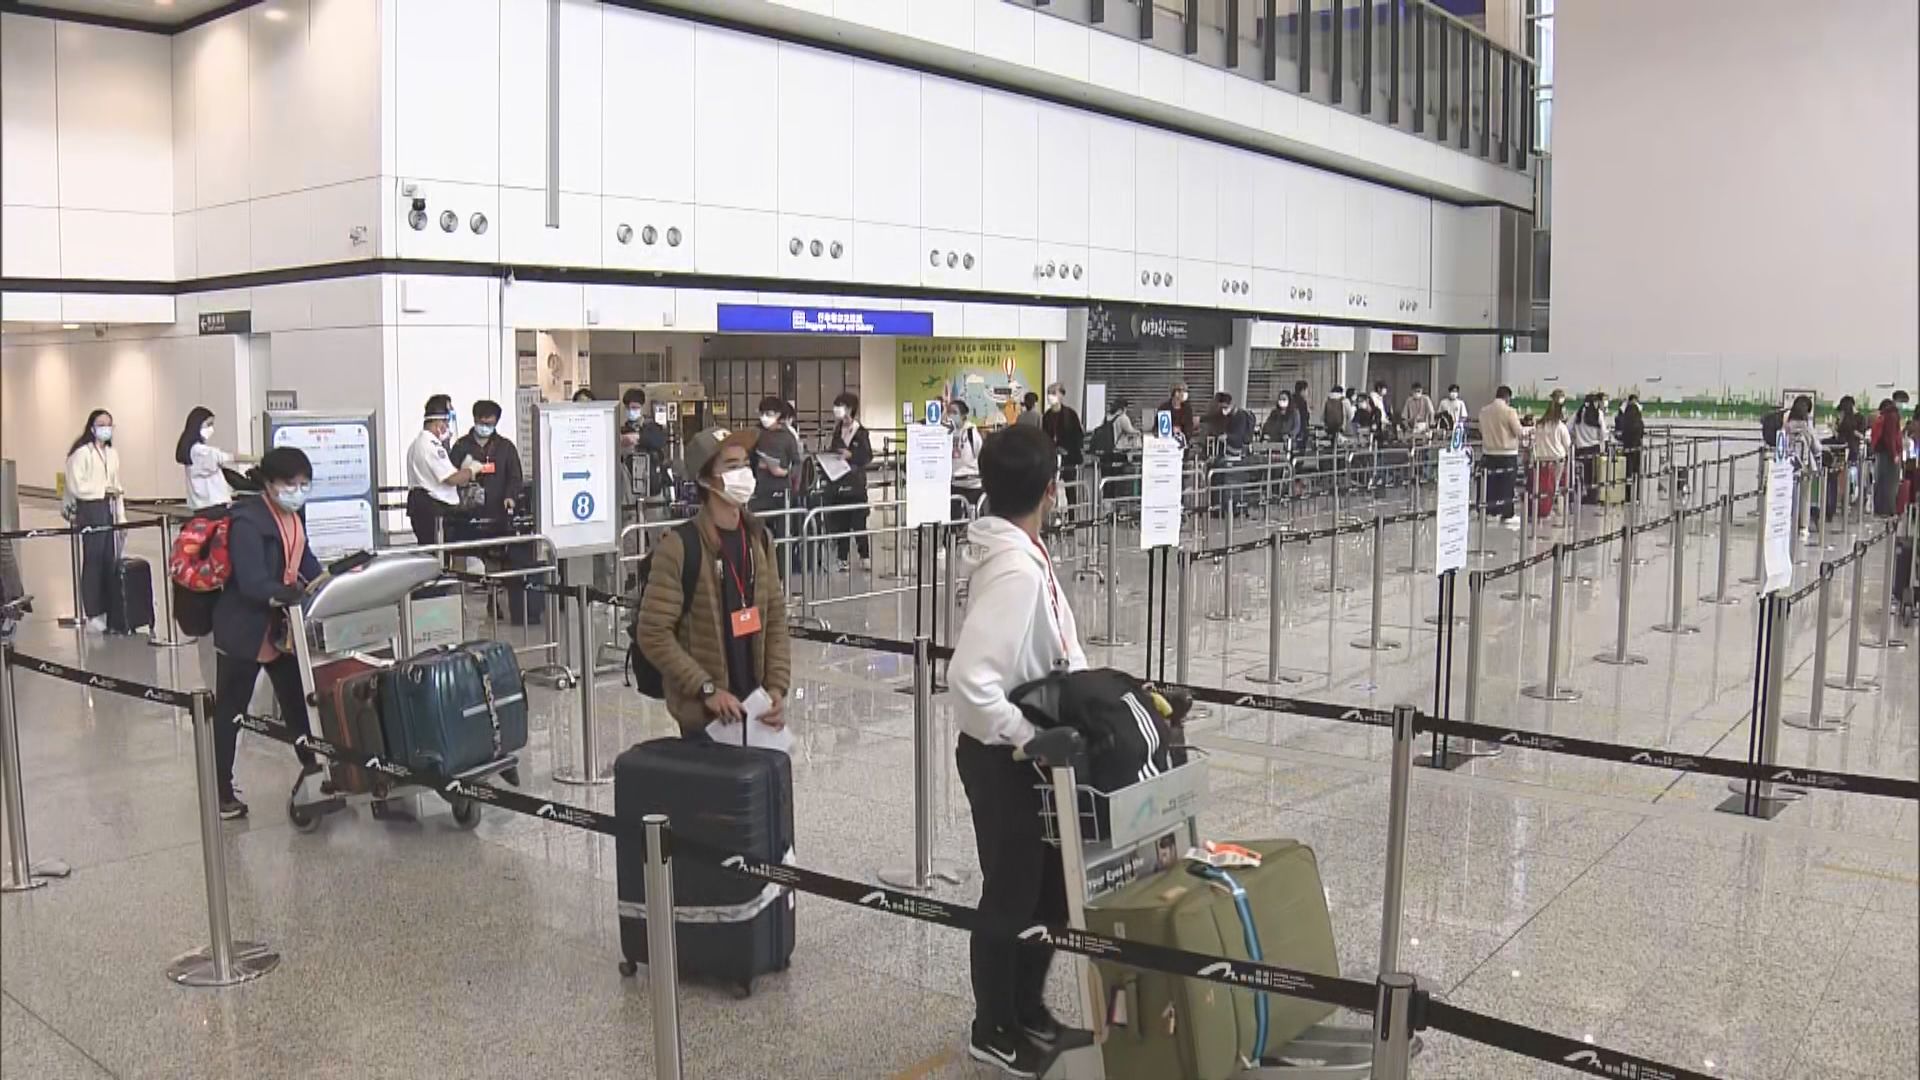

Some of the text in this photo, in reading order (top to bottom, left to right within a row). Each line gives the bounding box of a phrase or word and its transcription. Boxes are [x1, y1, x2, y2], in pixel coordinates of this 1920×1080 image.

[902, 343, 928, 352] Leave
[931, 343, 952, 354] your
[979, 342, 1001, 352] with
[1005, 343, 1016, 352] us
[902, 354, 1001, 366] and explore the city!
[930, 404, 937, 421] 1
[1160, 415, 1169, 433] 2
[576, 495, 590, 518] 8
